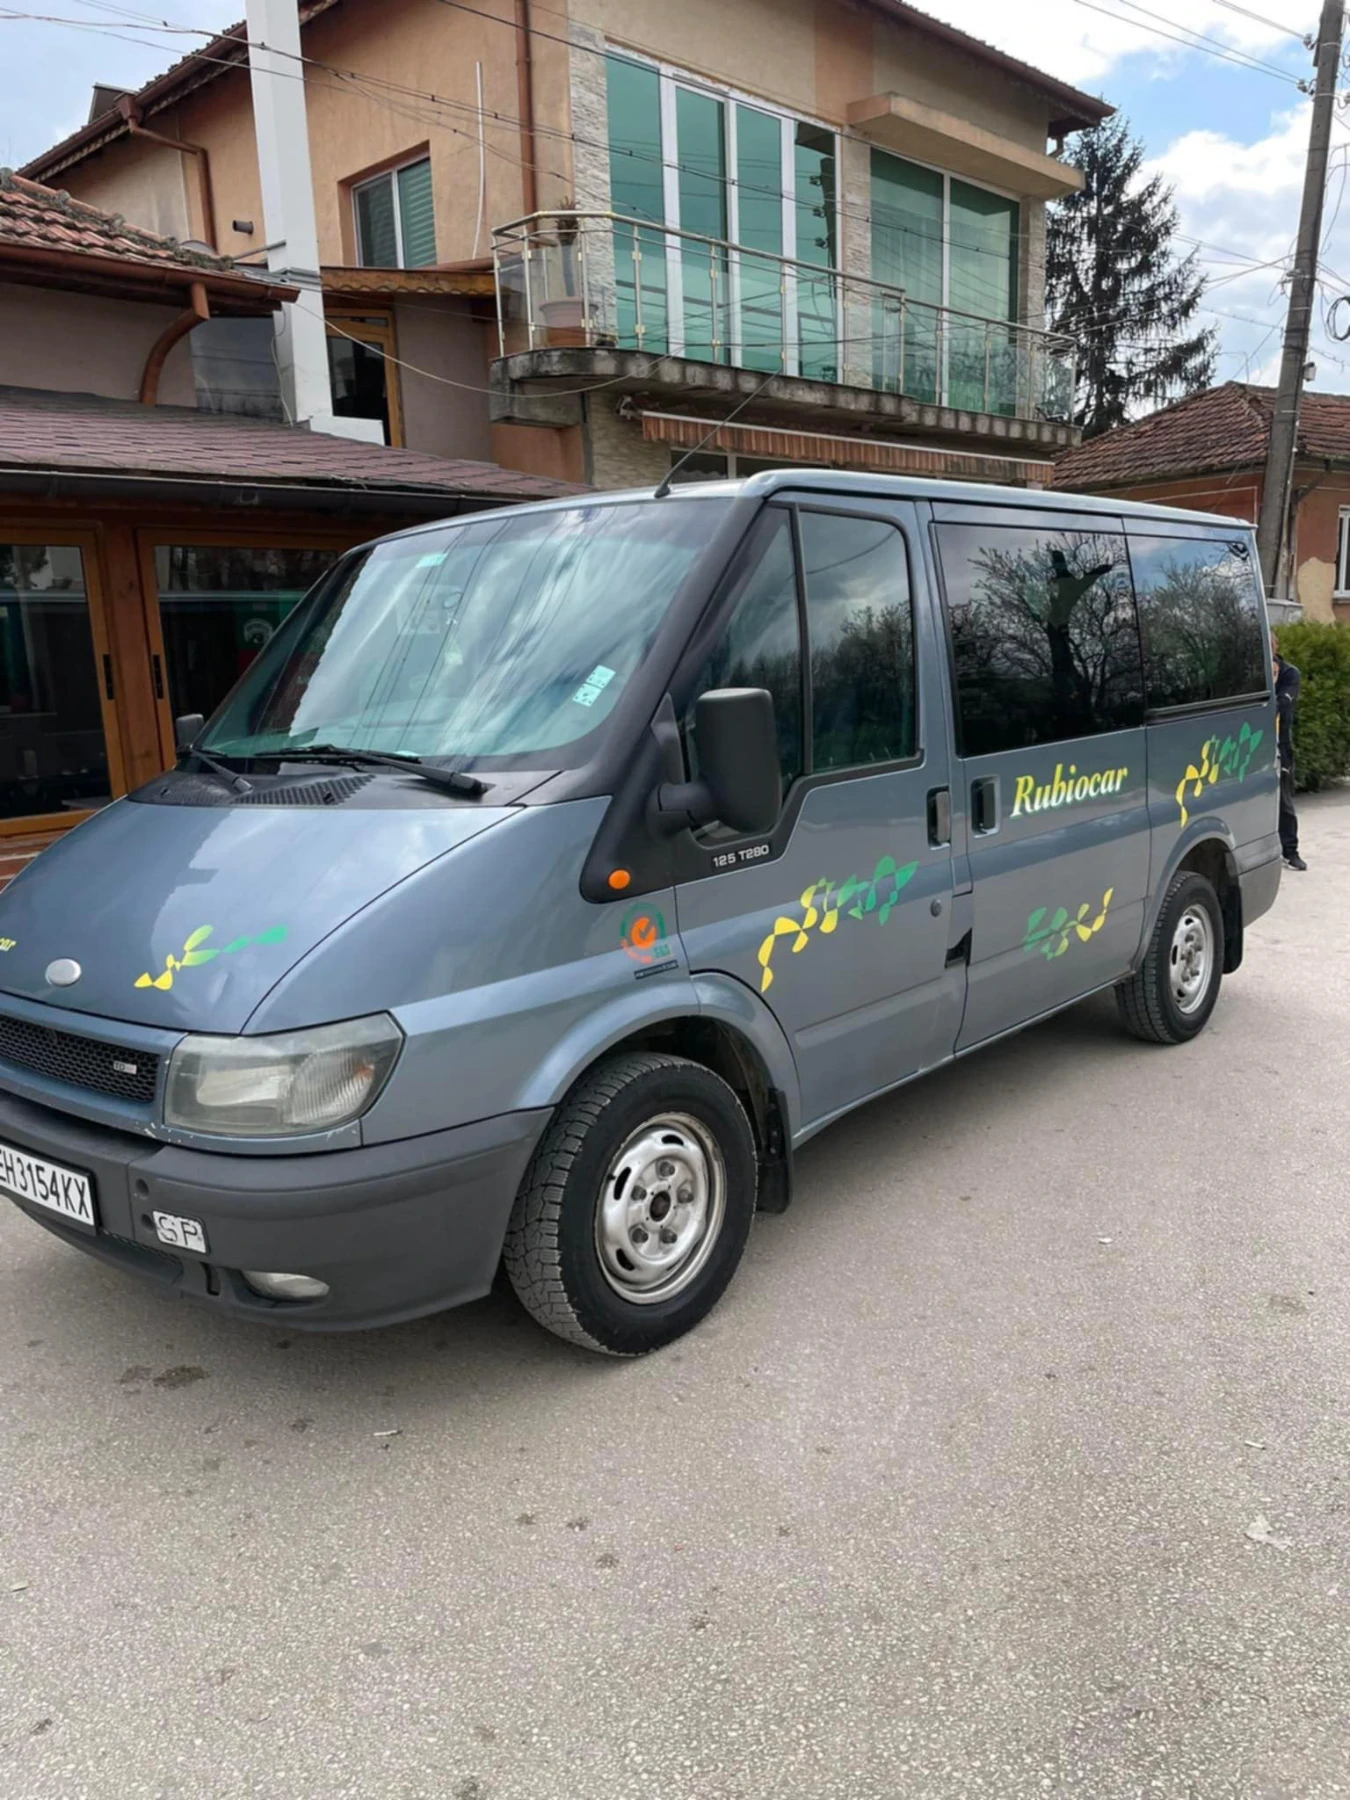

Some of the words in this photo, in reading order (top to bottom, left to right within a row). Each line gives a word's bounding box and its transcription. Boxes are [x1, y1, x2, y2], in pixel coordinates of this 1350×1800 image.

[1010, 763, 1129, 818] Rubiocar
[713, 853, 736, 868] 125
[738, 844, 770, 861] T280
[159, 1216, 198, 1246] SP
